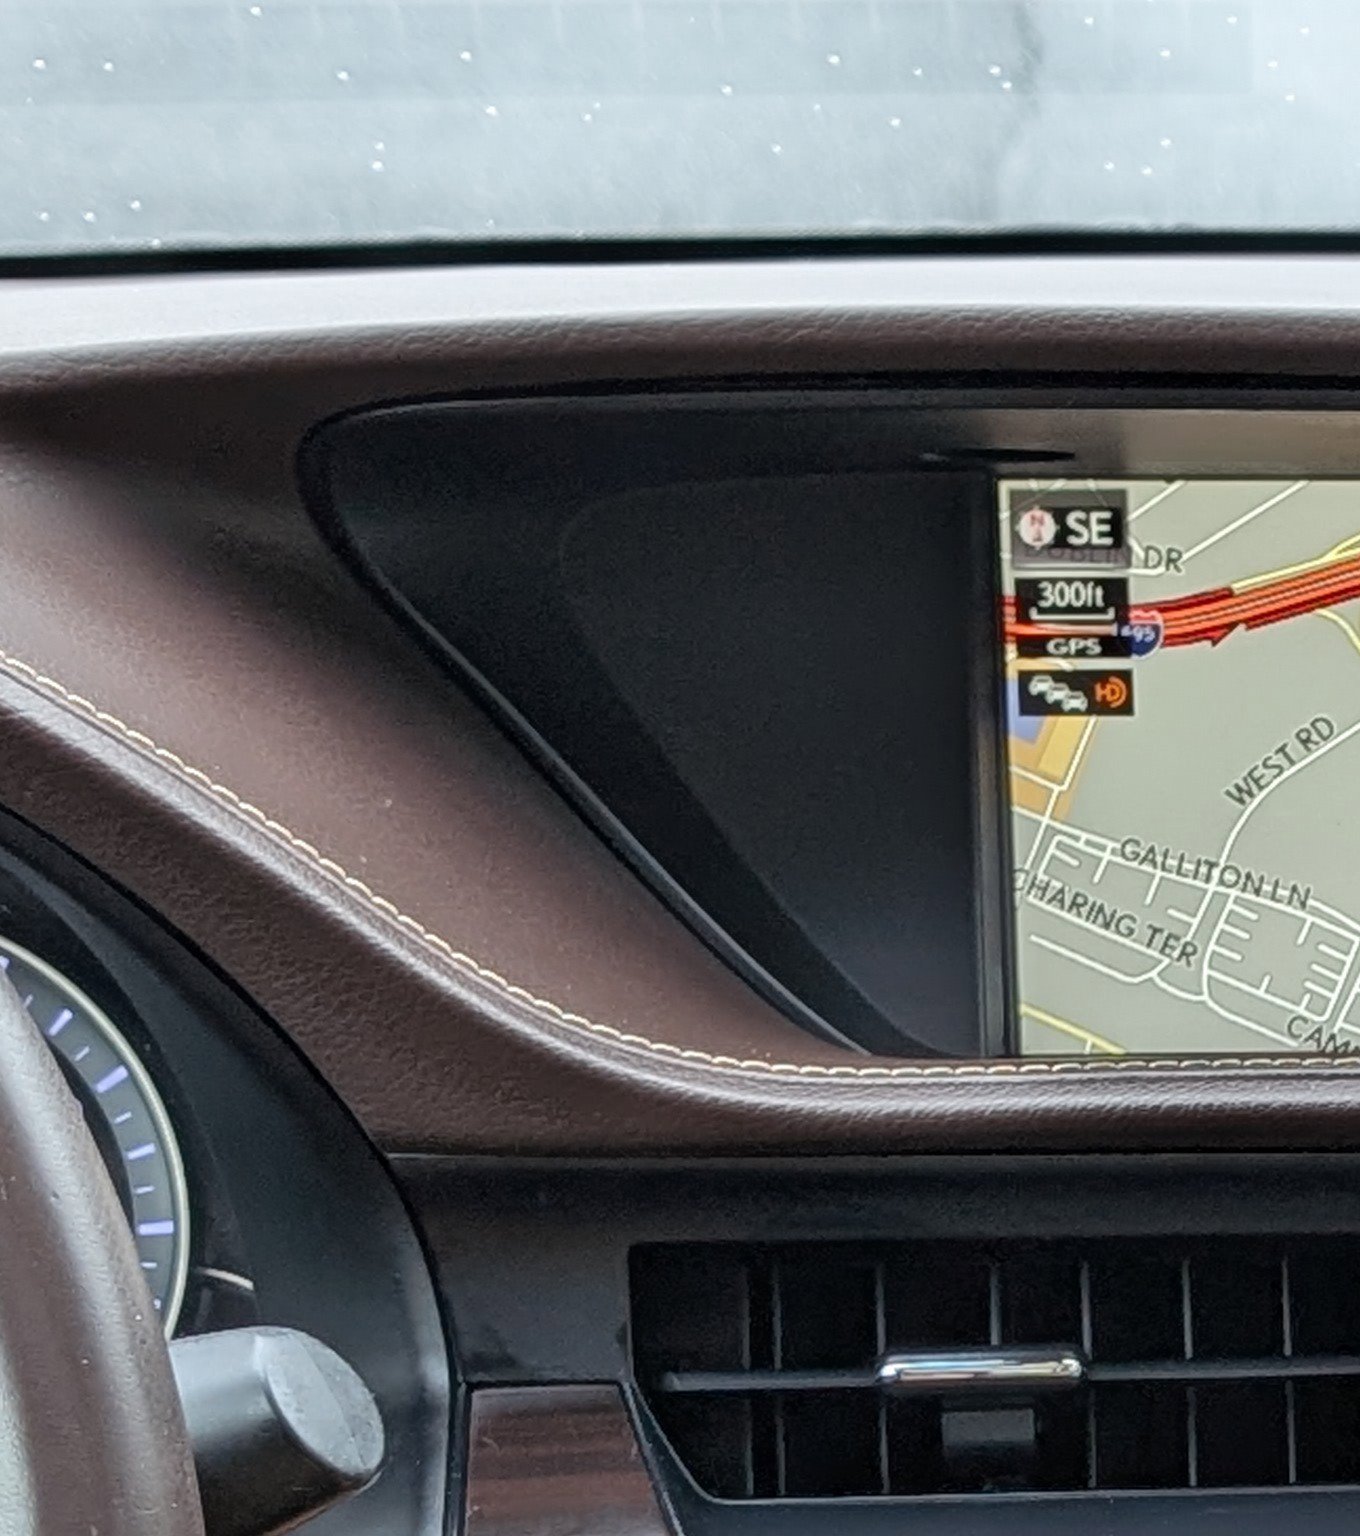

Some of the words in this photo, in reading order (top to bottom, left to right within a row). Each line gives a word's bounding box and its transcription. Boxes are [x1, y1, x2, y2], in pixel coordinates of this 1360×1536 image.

[1065, 510, 1114, 546] SE
[1143, 545, 1183, 573] DR
[1036, 580, 1105, 608] 300ft
[1046, 637, 1103, 656] GPS
[1223, 742, 1297, 807] WEST
[1294, 716, 1335, 753] RD
[1119, 837, 1265, 898] GALLITON
[1270, 877, 1312, 911] LN
[1146, 923, 1199, 968] TER
